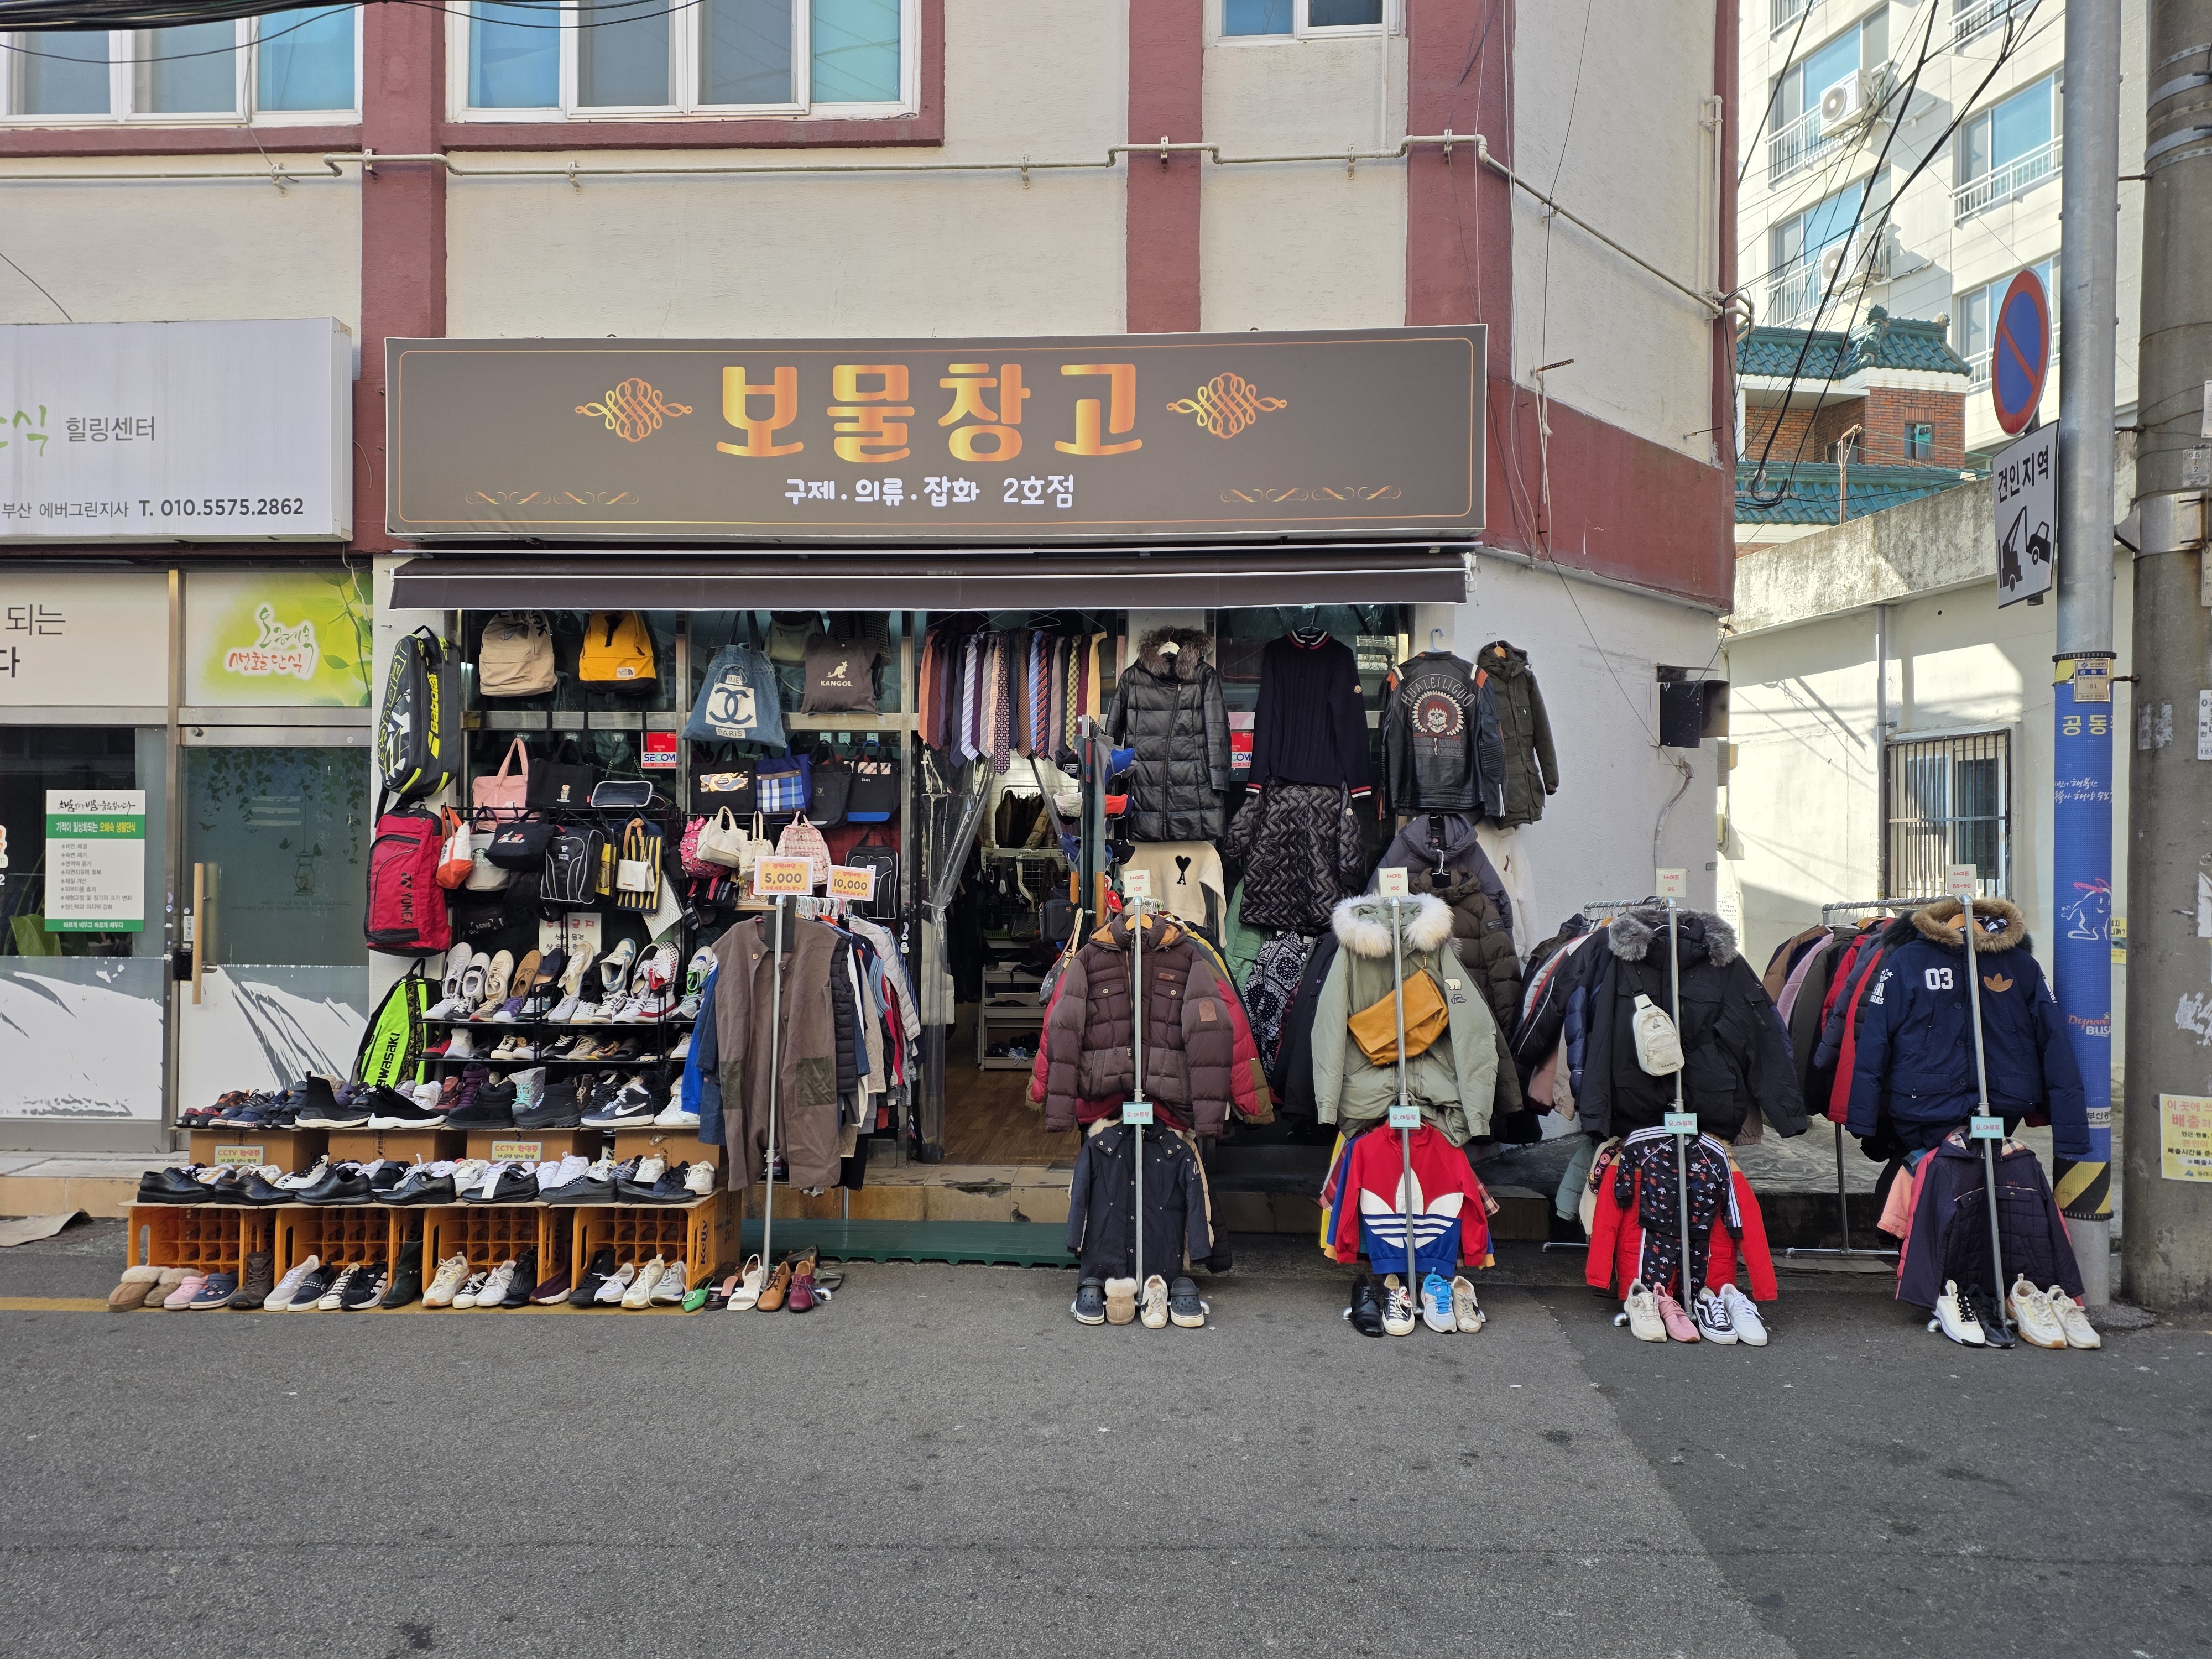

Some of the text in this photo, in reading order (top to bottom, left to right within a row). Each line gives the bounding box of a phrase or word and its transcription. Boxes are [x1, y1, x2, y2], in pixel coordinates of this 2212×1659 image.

[716, 363, 1142, 463] 보물창고
[66, 416, 156, 442] 힐링센터
[1997, 445, 2049, 504] 견인지역
[1003, 474, 1074, 508] 2호점
[2, 502, 32, 519] 부산
[39, 501, 129, 519] 에버그린지사
[161, 498, 304, 517] 010.5575.2862
[6, 604, 66, 635] 되는
[229, 651, 302, 674] 생활단식
[727, 676, 739, 684] RUE
[717, 728, 744, 737] PARIS
[2063, 714, 2112, 736] 공동
[644, 753, 675, 761] SECOM
[1232, 753, 1251, 761] COM
[56, 821, 71, 833] 기적이
[73, 821, 98, 833] 일상화되는
[116, 821, 136, 833] 생활단식
[764, 873, 802, 884] 5,000
[833, 878, 868, 890] 10,000
[400, 892, 413, 925] YONEX
[1925, 967, 1953, 990] 03
[2167, 1100, 2176, 1110] 이
[2180, 1100, 2200, 1112] 곳에
